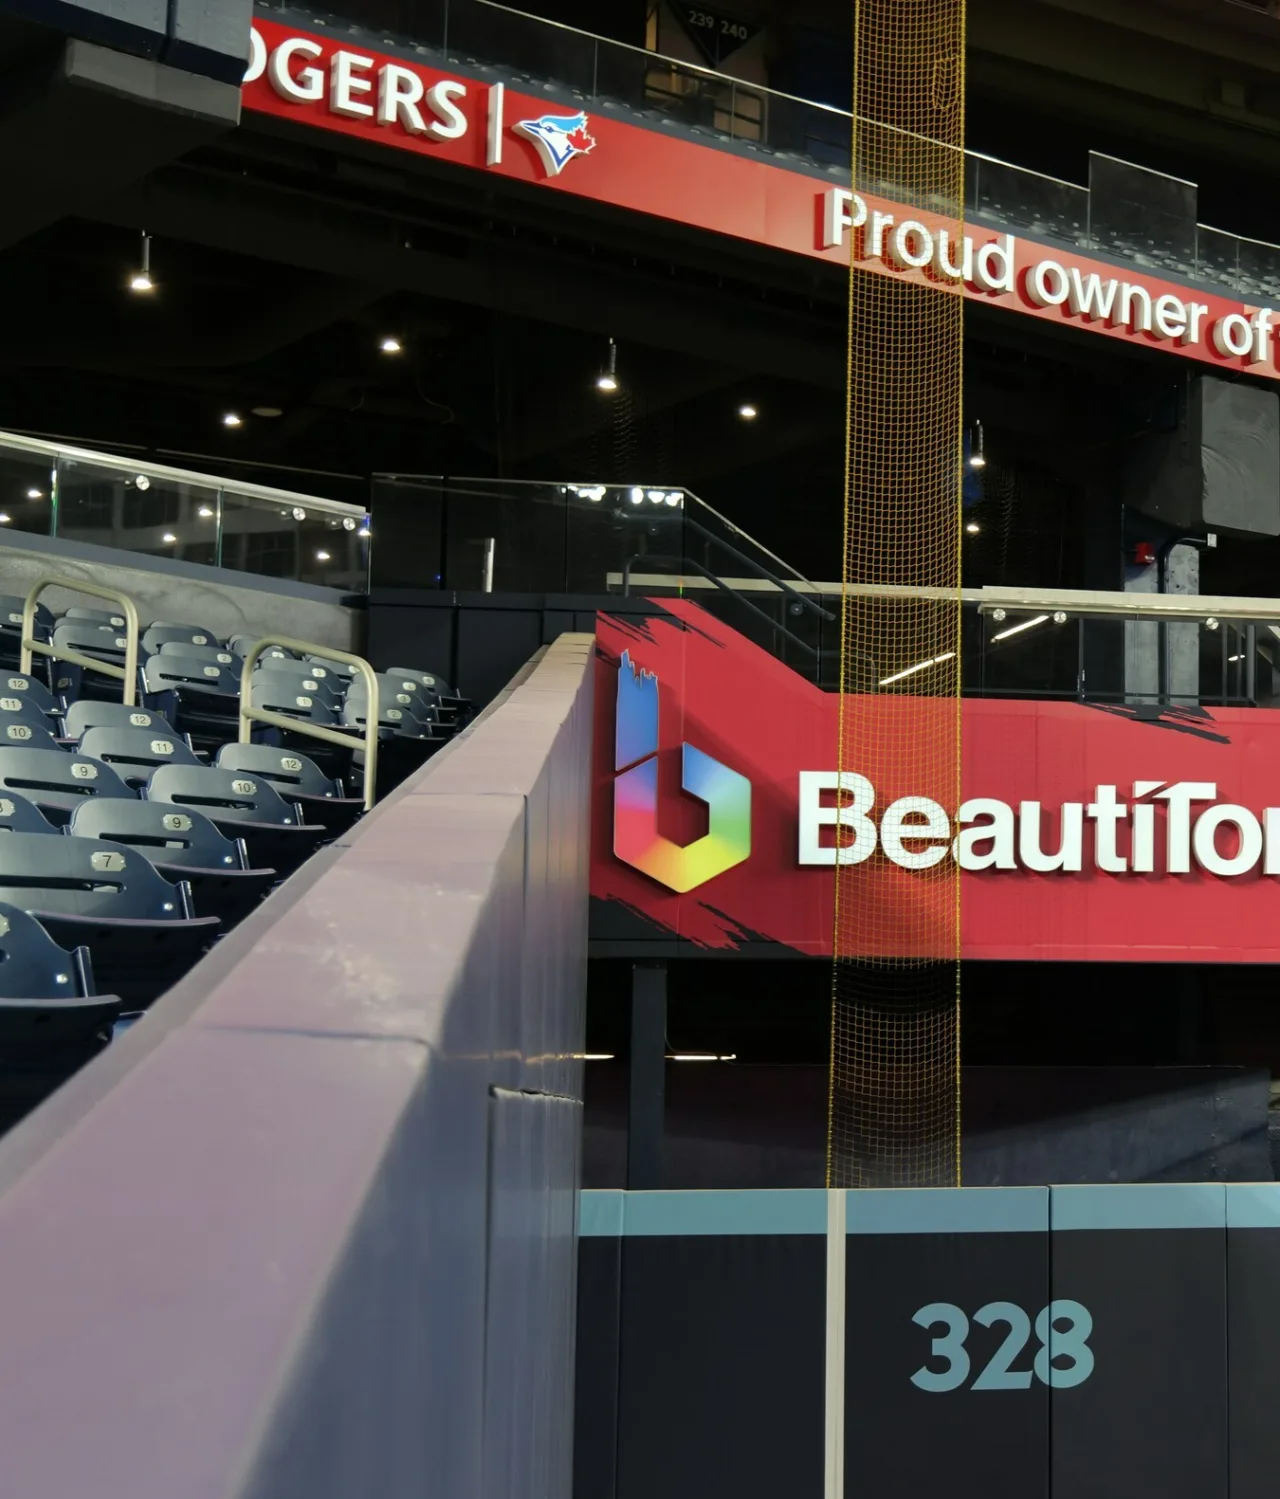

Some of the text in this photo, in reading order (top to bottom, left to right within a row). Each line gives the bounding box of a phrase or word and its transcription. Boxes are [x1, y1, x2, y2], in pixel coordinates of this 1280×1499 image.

[826, 188, 1015, 294] Proud
[1029, 258, 1208, 345] owner
[1215, 308, 1273, 362] of
[13, 680, 24, 689] 12
[5, 700, 16, 709] 11
[135, 715, 147, 725] 12
[12, 727, 26, 738] 10
[156, 743, 167, 752] 11
[285, 760, 297, 769] 12
[80, 766, 88, 777] 9
[237, 782, 251, 793] 10
[172, 817, 181, 829] 9
[102, 854, 112, 868] 7
[910, 1299, 1094, 1392] 328
